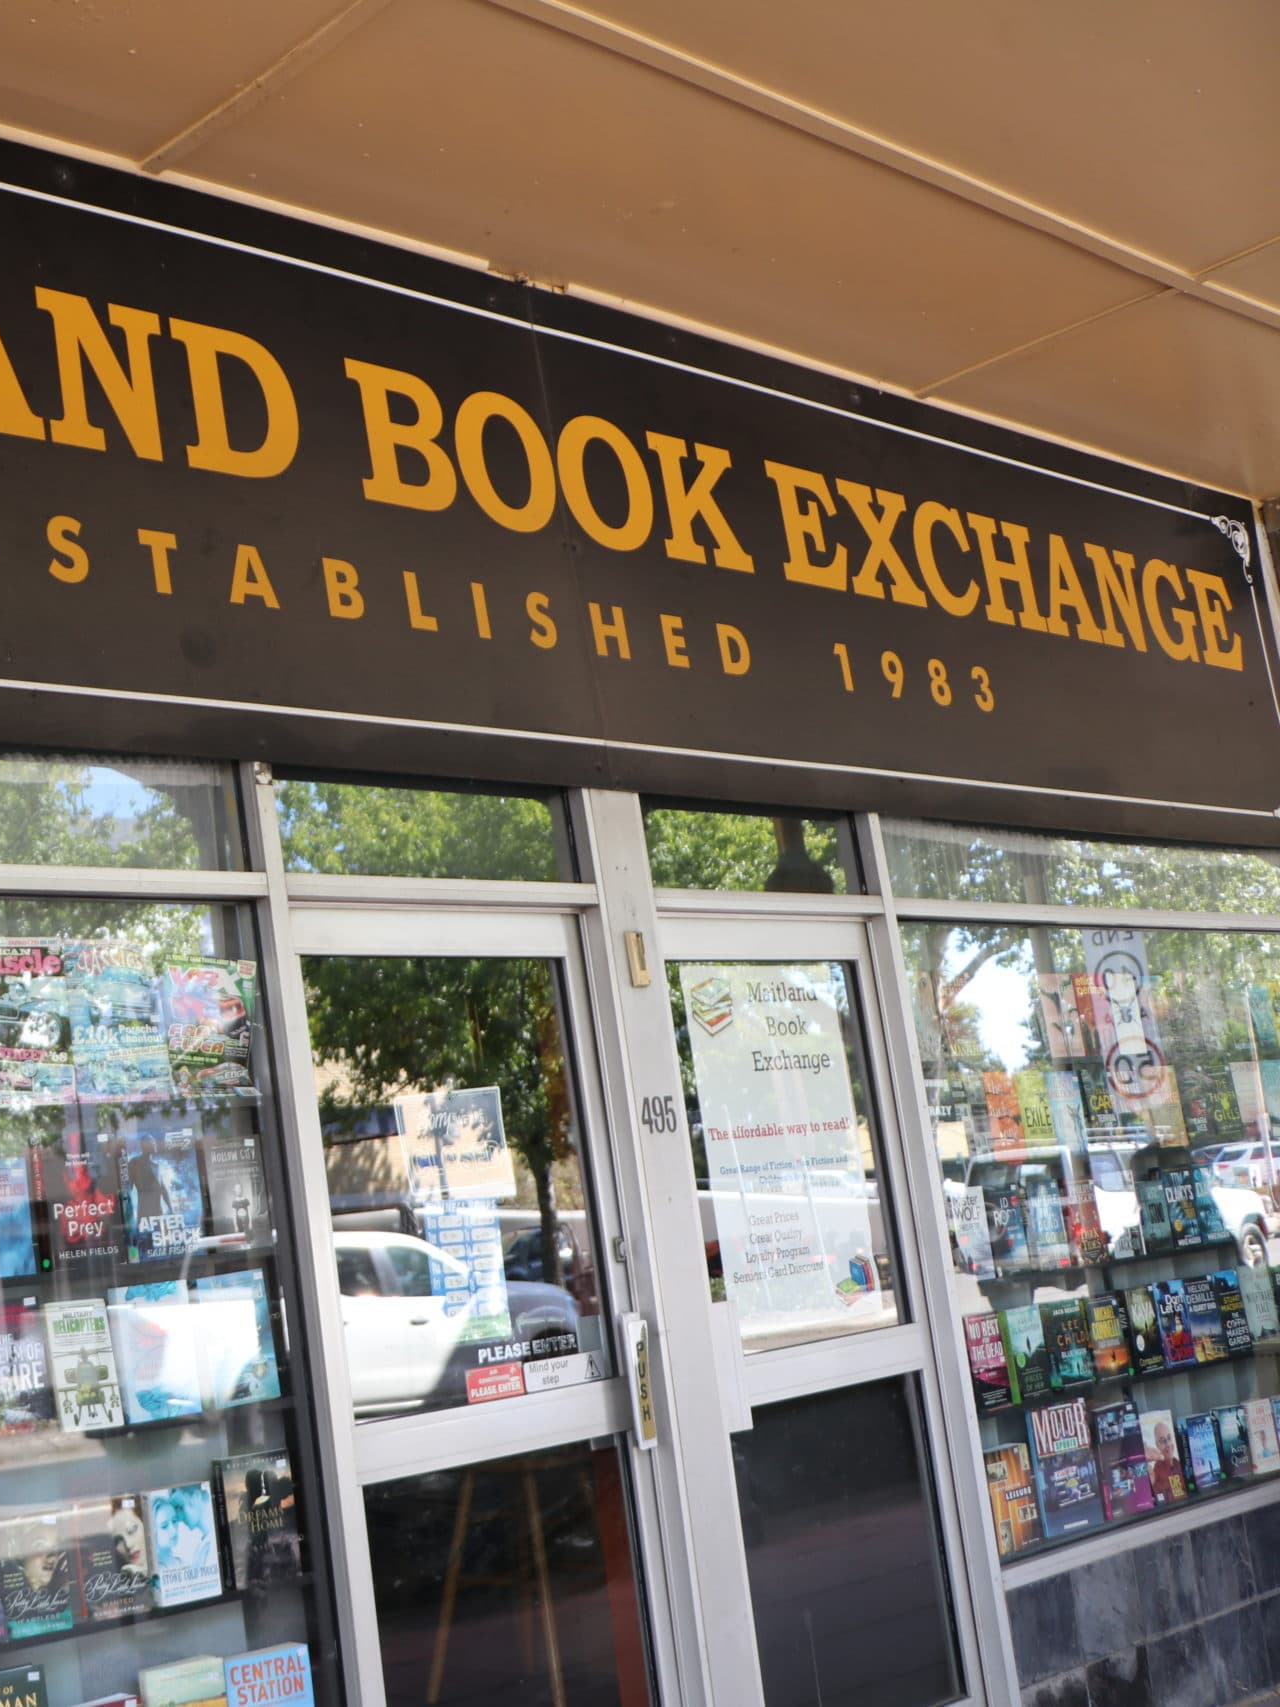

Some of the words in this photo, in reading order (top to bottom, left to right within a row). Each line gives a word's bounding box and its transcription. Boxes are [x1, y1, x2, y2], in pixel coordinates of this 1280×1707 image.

[344, 357, 755, 575] BOOK
[764, 459, 1244, 672] EXCHANGE
[833, 642, 995, 713] 1983
[746, 981, 818, 1003] Maitland
[766, 1017, 809, 1036] Book
[752, 1050, 831, 1073] Exchange
[641, 1096, 677, 1134] 495
[1025, 1106, 1052, 1128] EXILE
[708, 1127, 729, 1141] The
[732, 1120, 784, 1140] affordable
[788, 1122, 807, 1135] way
[810, 1120, 820, 1132] to
[823, 1117, 850, 1131] read!
[720, 1166, 738, 1175] Great
[741, 1164, 760, 1174] Range
[811, 1157, 833, 1167] Fiction
[53, 1198, 115, 1219] Perfect
[67, 1219, 103, 1237] Prey
[139, 1215, 185, 1233] AFTER
[749, 1215, 773, 1225] Great
[152, 1227, 200, 1246] SHOCK
[58, 1249, 87, 1260] HELEN
[89, 1245, 119, 1257] FIELDS
[776, 1246, 810, 1259] Program
[768, 1265, 787, 1278] Card
[1187, 1284, 1210, 1293] NELSON
[1187, 1292, 1215, 1304] DEMILLE
[1132, 1303, 1155, 1322] KAVA
[969, 1323, 979, 1340] NO
[982, 1319, 999, 1336] REST
[1062, 1320, 1079, 1331] LEE
[1226, 1320, 1246, 1328] COFFIN
[1056, 1331, 1087, 1346] CHILD
[1229, 1336, 1251, 1346] GARDEN
[478, 1341, 531, 1364] PLEASE
[532, 1334, 577, 1354] ENTER
[972, 1345, 986, 1360] THE
[986, 1341, 1003, 1358] DEAD
[529, 1362, 548, 1373] Mind
[551, 1360, 568, 1371] your
[471, 1387, 497, 1397] PLEASE
[498, 1382, 523, 1392] ENTER
[542, 1375, 560, 1386] step
[636, 1341, 653, 1421] PUSH
[1032, 1403, 1090, 1456] MOTOR
[1006, 1487, 1032, 1499] LEISURE
[230, 1656, 306, 1685] CENTRAL
[3, 1685, 14, 1695] OF
[237, 1676, 305, 1706] STATION
